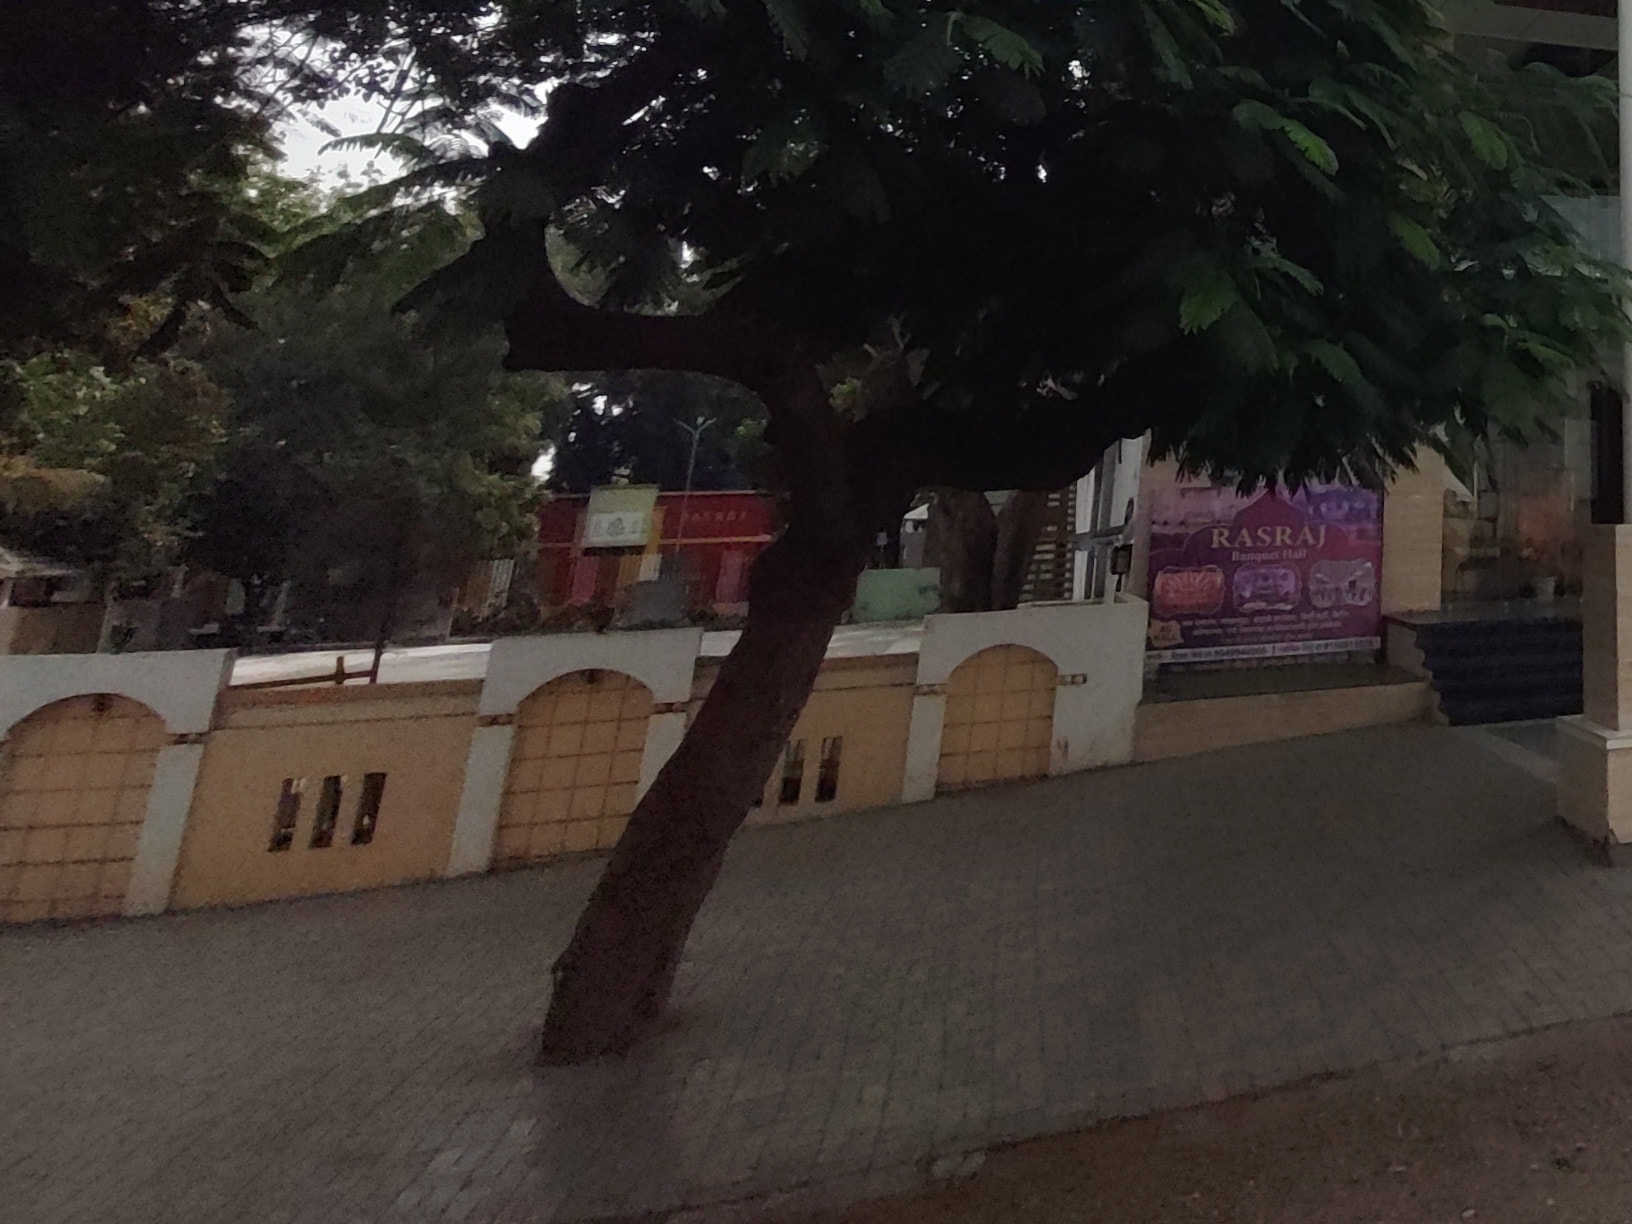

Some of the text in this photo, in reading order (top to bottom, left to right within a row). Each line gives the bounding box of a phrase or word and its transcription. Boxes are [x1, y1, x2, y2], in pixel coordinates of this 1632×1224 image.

[1211, 525, 1326, 548] RASRAJ
[1232, 548, 1306, 563] Banquet Hall
